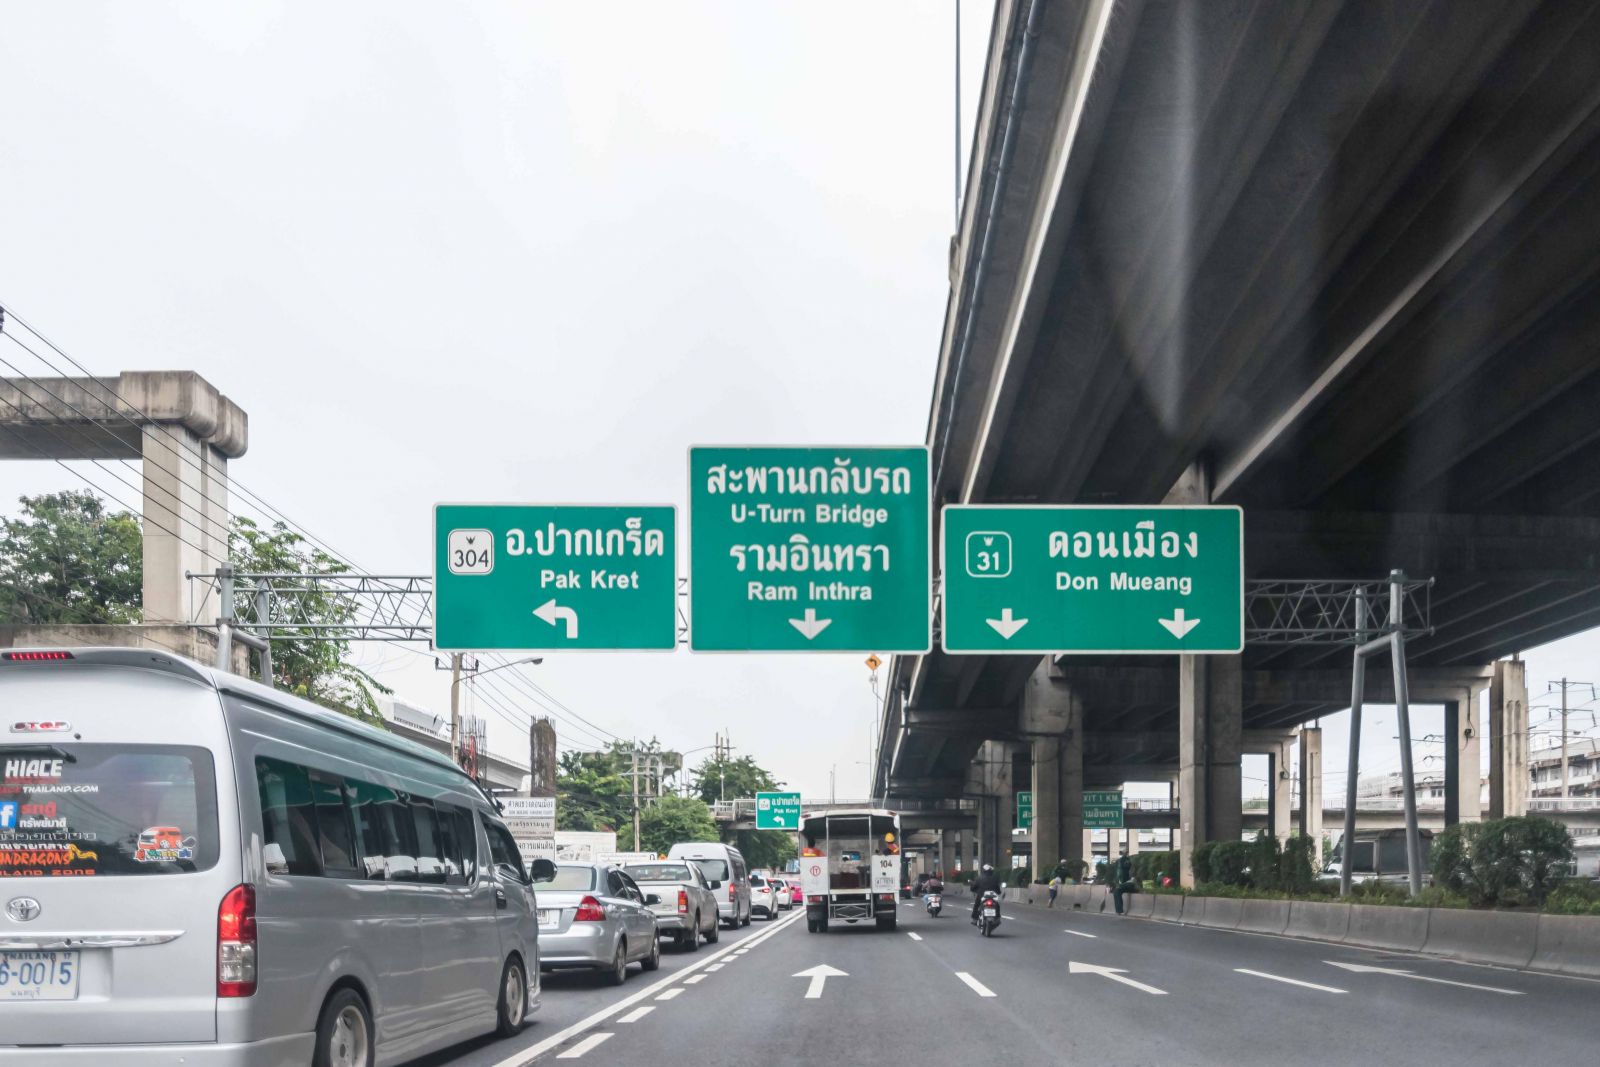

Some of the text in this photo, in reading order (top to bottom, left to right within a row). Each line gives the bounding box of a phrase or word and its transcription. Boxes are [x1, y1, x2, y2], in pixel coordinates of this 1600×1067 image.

[707, 457, 911, 494] สะพานกลับรถ
[731, 503, 888, 528] U-Turn Bridge
[506, 516, 665, 556] อ.ปากเกร็ด
[1049, 520, 1198, 558] ดอนเมือง
[454, 549, 489, 568] 304
[730, 534, 890, 572] รามอินทรา
[976, 551, 1000, 571] 31
[540, 569, 639, 589] Pak Kret
[1056, 572, 1193, 596] Don Mueang
[748, 581, 872, 601] Ram Inthra
[5, 759, 64, 777] HIACE
[1084, 808, 1119, 818] ามอินทรา
[880, 859, 892, 868] 104
